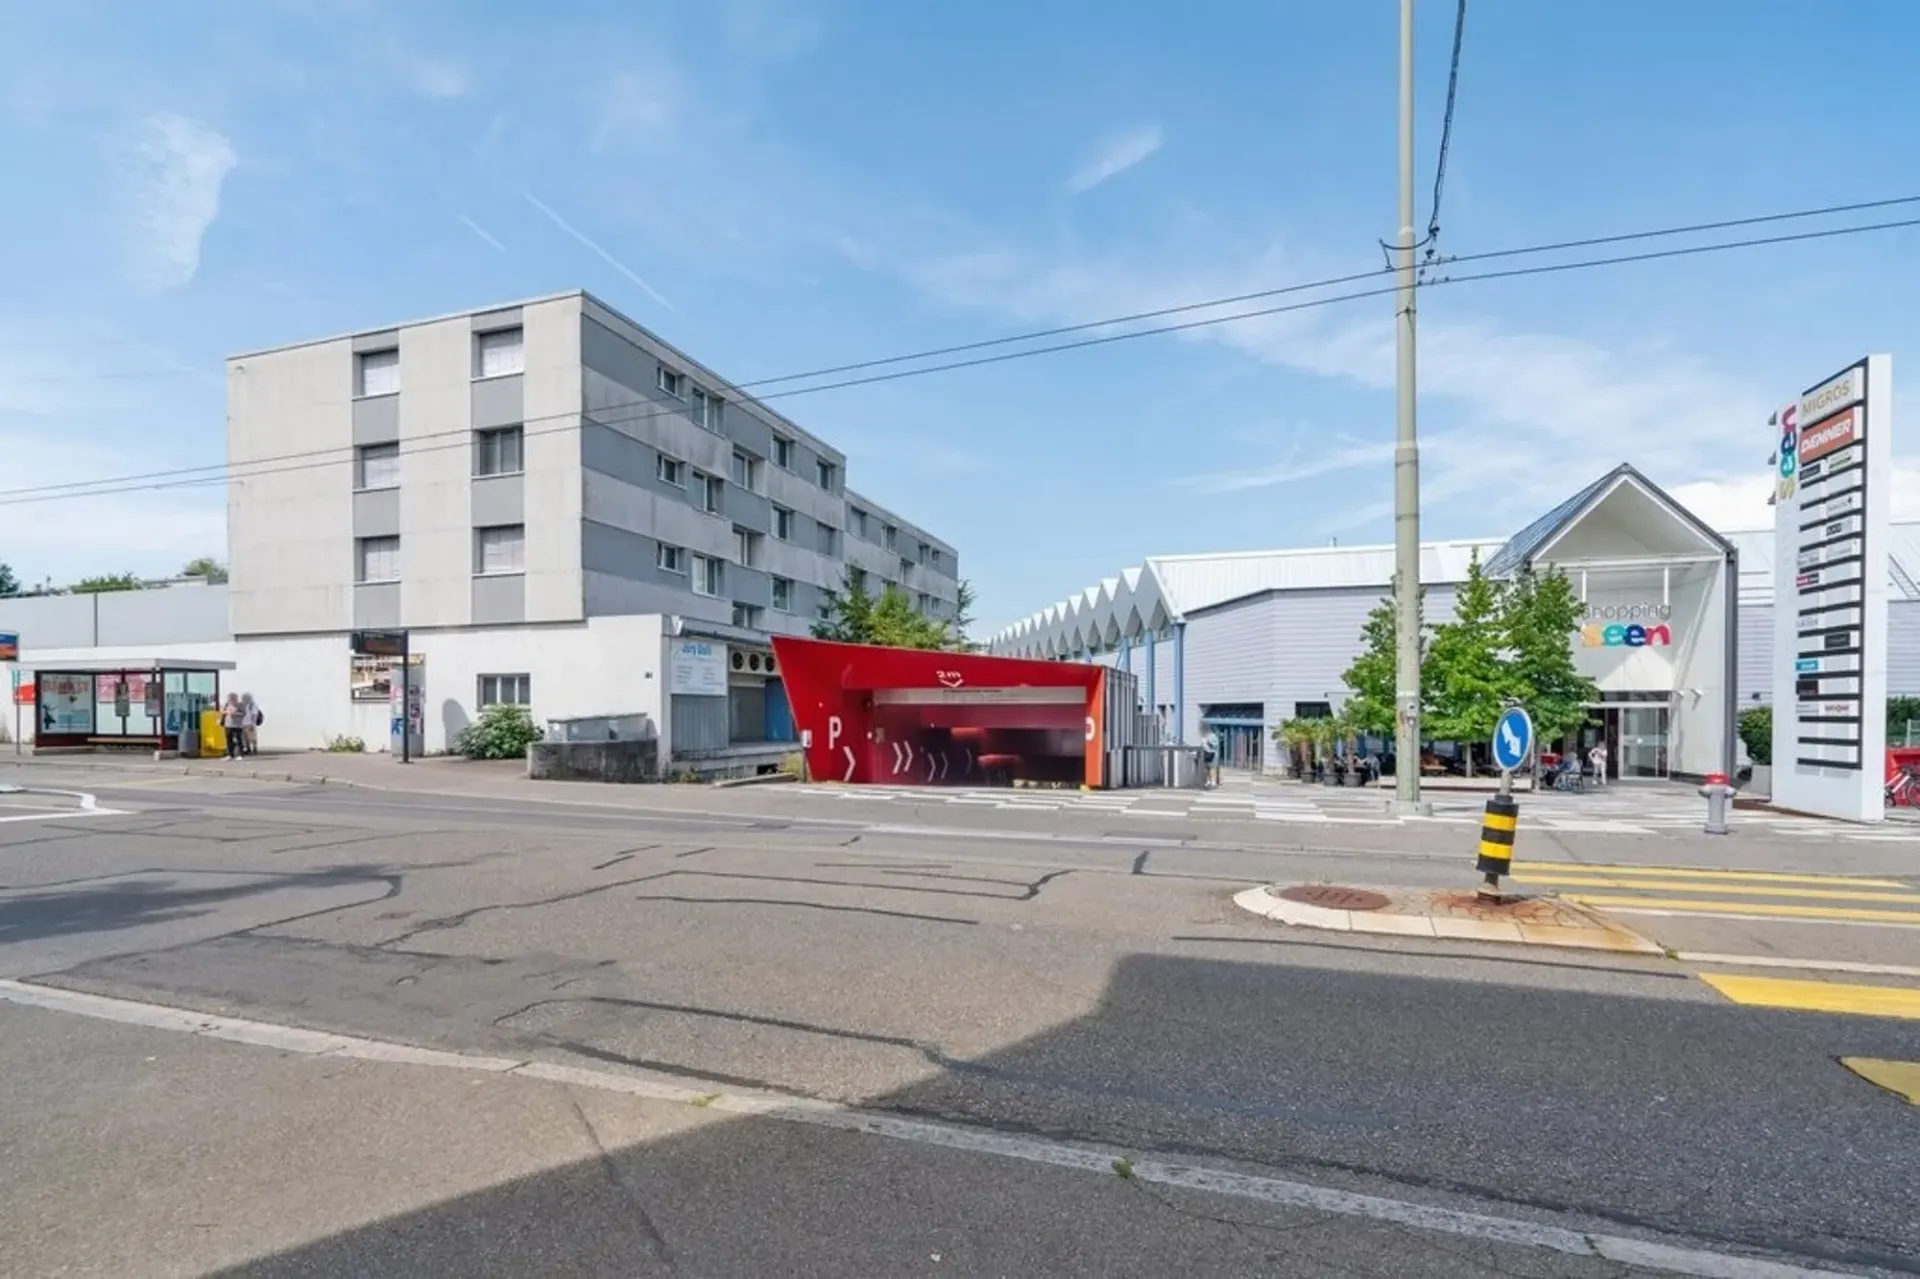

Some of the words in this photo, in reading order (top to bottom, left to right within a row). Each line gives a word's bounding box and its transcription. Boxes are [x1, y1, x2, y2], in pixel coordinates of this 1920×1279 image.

[1802, 380, 1850, 414] MIGROS
[1800, 418, 1852, 454] DENNER
[1582, 624, 1671, 647] seen
[828, 715, 842, 751] P
